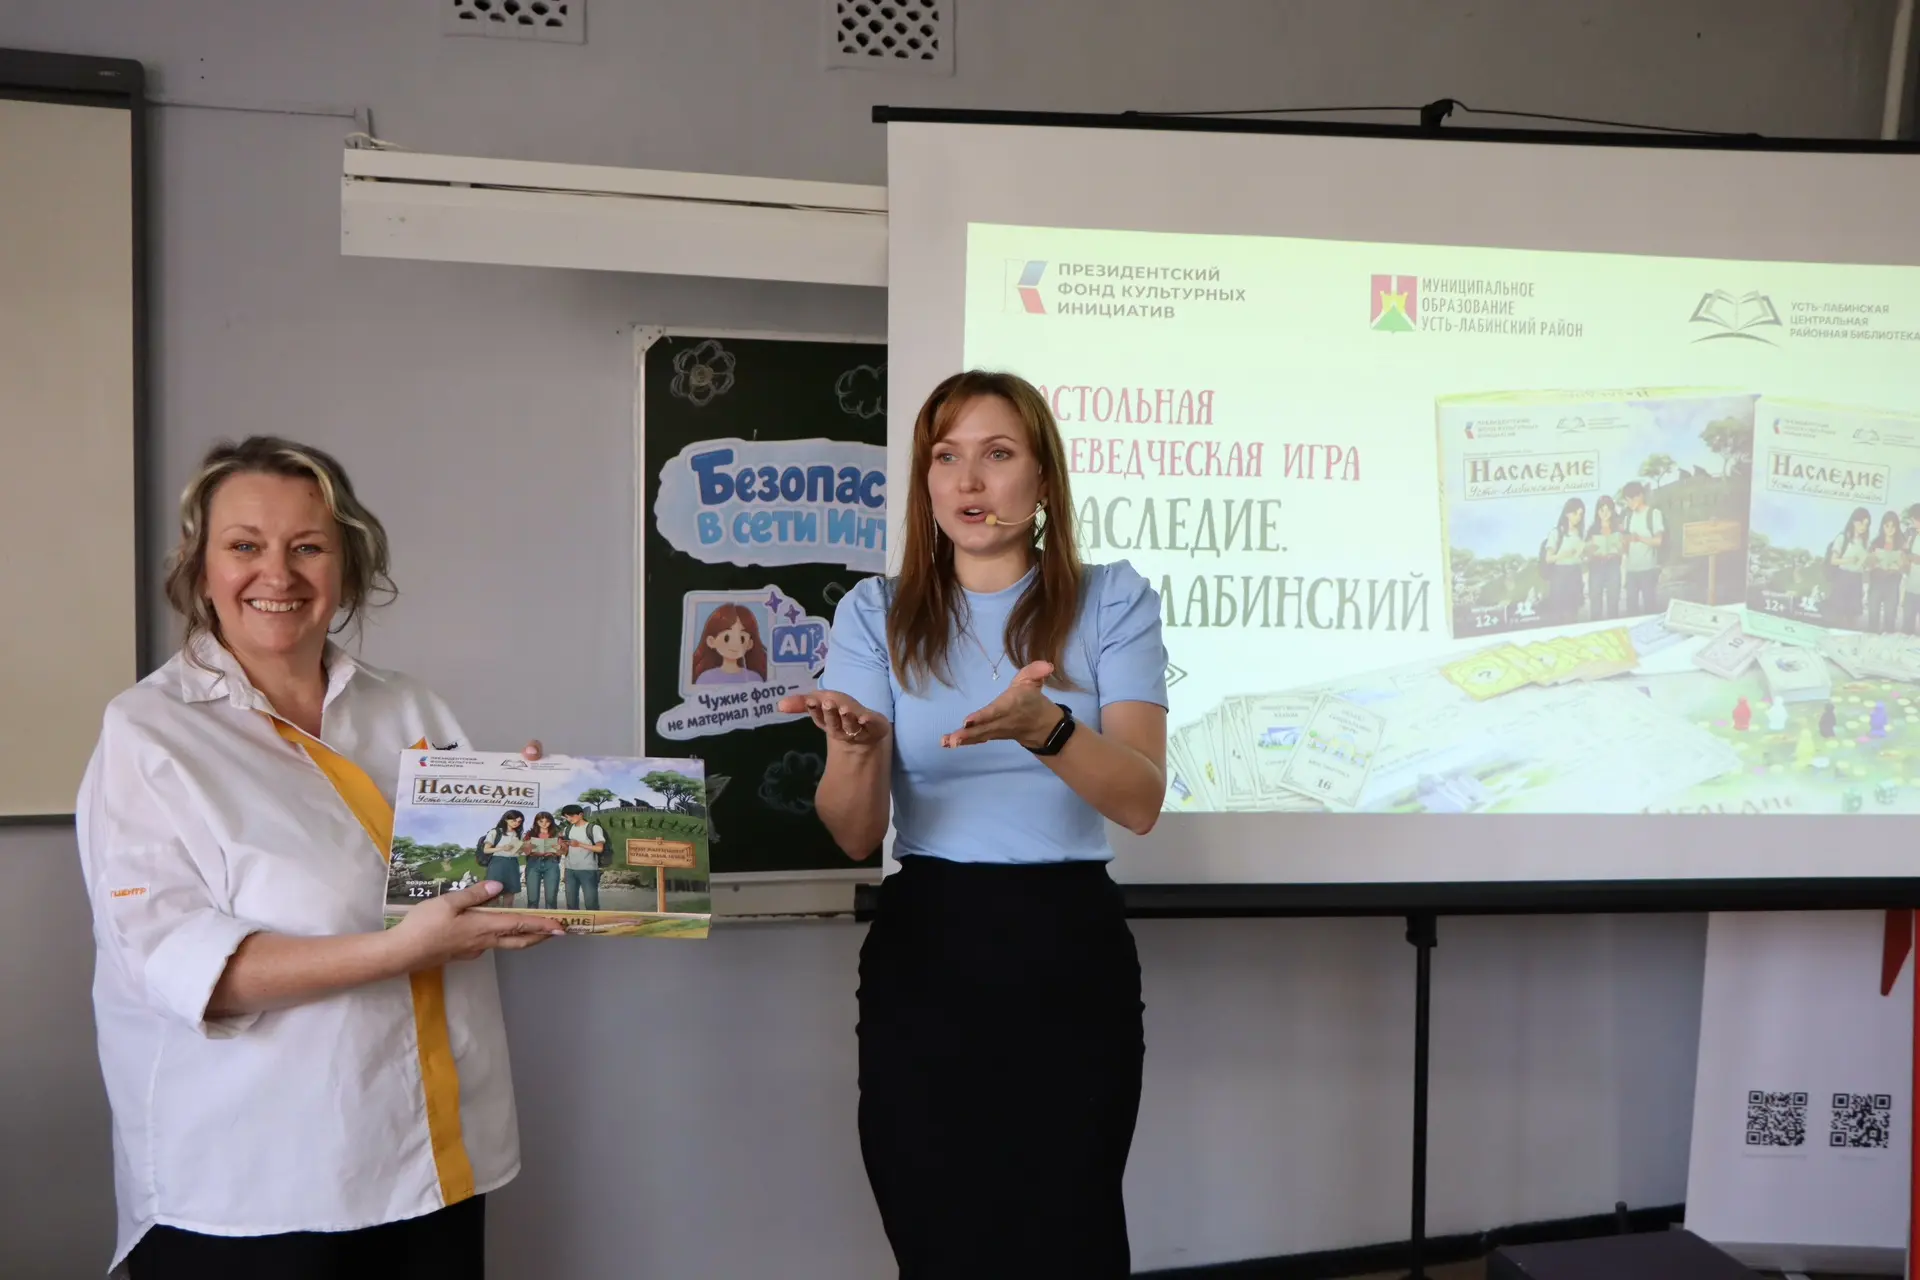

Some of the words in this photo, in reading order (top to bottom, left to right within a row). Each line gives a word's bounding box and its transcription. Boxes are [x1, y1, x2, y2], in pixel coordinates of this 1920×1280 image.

[1058, 263, 1220, 281] ПРЕЗИДЕНТСКИЙ
[1058, 282, 1115, 299] ФОНД
[1122, 285, 1246, 301] КУЛЬТУРНЫХ
[1422, 277, 1535, 297] МУНИЦИПАЛЬНОЕ
[1057, 302, 1176, 319] ИНИЦИАТИВ
[1422, 297, 1515, 315] ОБРАЗОВАНИЕ
[1790, 302, 1890, 313] УСТЬ-ЛАБИНСКАЯ
[1421, 316, 1536, 336] УСТЬ-ЛАБИНСКИЙ
[1540, 319, 1583, 337] РАЙОН
[1790, 315, 1868, 326] ЦЕНТРАЛЬНАЯ
[1790, 328, 1848, 339] РАЙОННАЯ
[1850, 330, 1920, 341] БИБЛИОТЕКА
[1038, 384, 1215, 425] СТОЛЬНАЯ
[1067, 437, 1264, 479] ЕВЕДЧЕСКАЯ
[1283, 443, 1361, 481] ИГРА
[691, 448, 887, 509] Безопас
[697, 511, 723, 545] в
[733, 510, 817, 544] сети
[1078, 496, 1288, 557] АСЛЕДИЕ.
[1160, 572, 1430, 632] ЛАБИНСКИЙ
[1475, 614, 1500, 628] 12+
[780, 634, 808, 655] AI
[698, 691, 749, 711] Чужие
[751, 685, 786, 701] фото
[668, 720, 684, 732] не
[687, 707, 749, 728] материал
[408, 887, 433, 897] 12+
